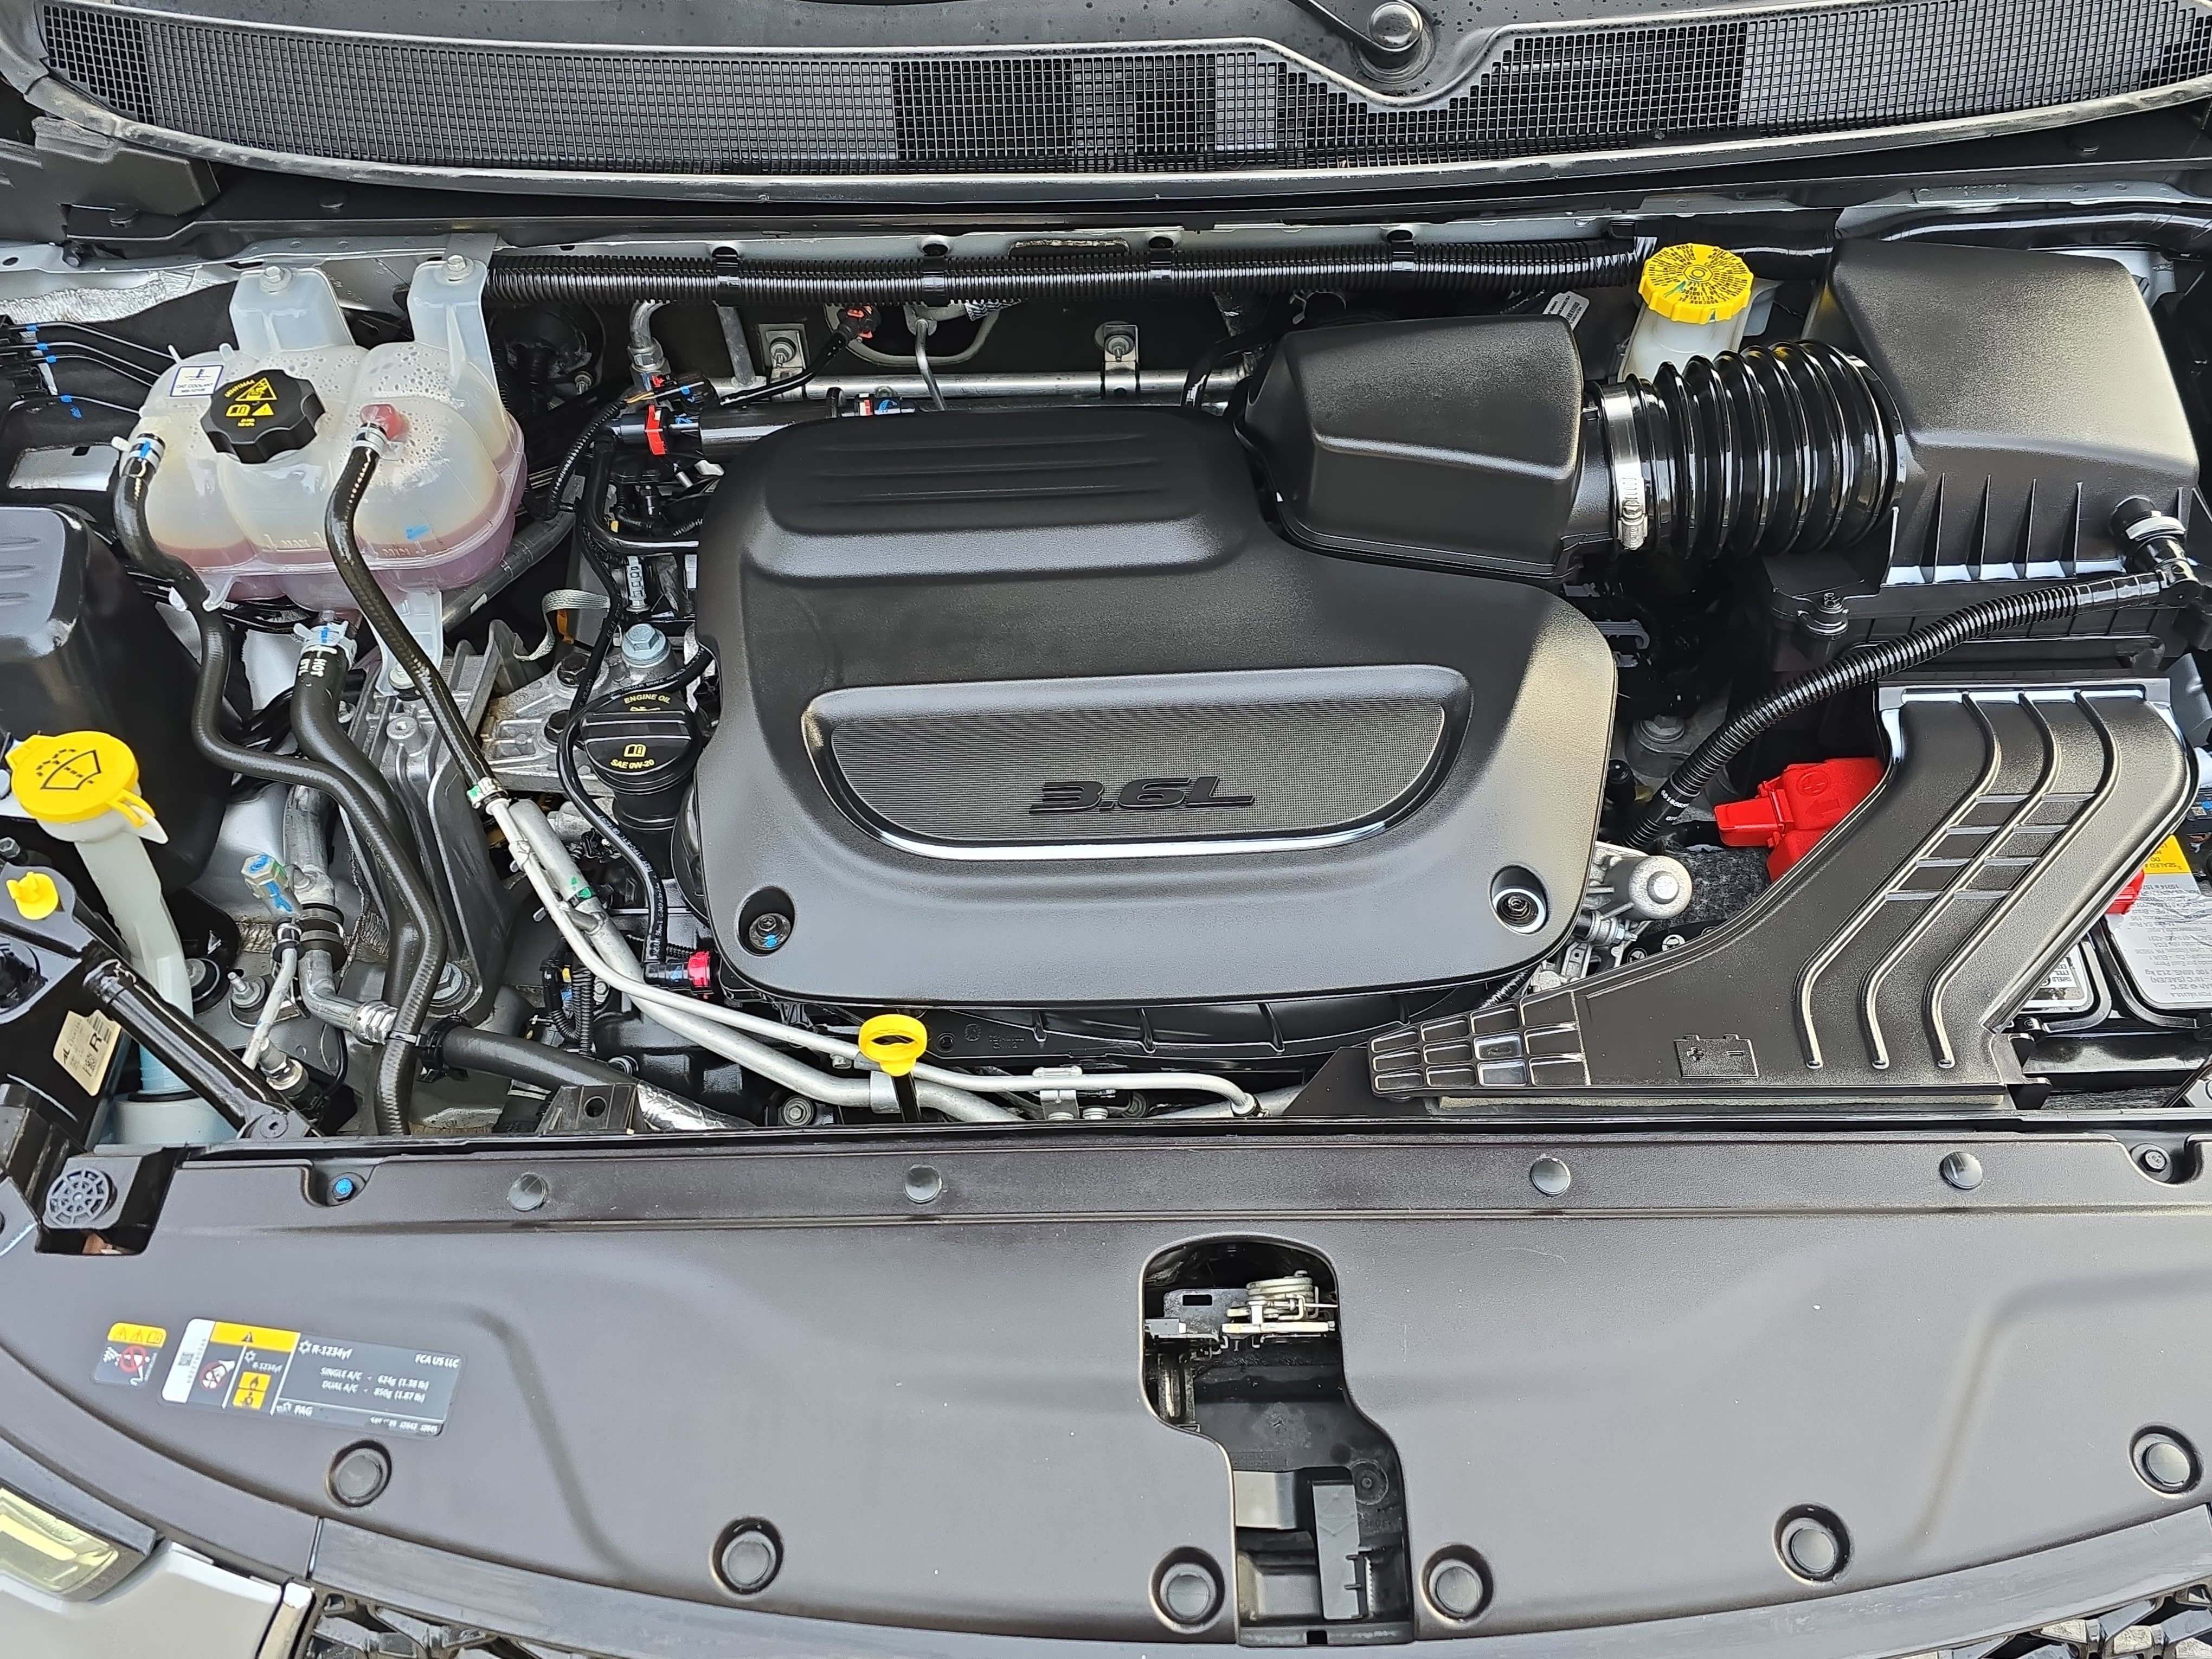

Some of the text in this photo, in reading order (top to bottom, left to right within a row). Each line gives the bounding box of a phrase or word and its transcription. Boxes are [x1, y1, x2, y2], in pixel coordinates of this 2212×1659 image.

[310, 659, 327, 677] HOT
[624, 694, 672, 704] ENGINE OIL
[610, 759, 655, 769] SAE 0W-20
[1028, 776, 1255, 815] 3.6L
[89, 1032, 102, 1053] R
[312, 1345, 352, 1360] R-1234yf
[415, 1354, 460, 1368] FCA US LLC
[320, 1367, 347, 1379] SINGLE
[347, 1370, 363, 1381] A/C
[322, 1380, 342, 1392] DUAL
[343, 1383, 359, 1394] A/C
[294, 1405, 313, 1417] PAG
